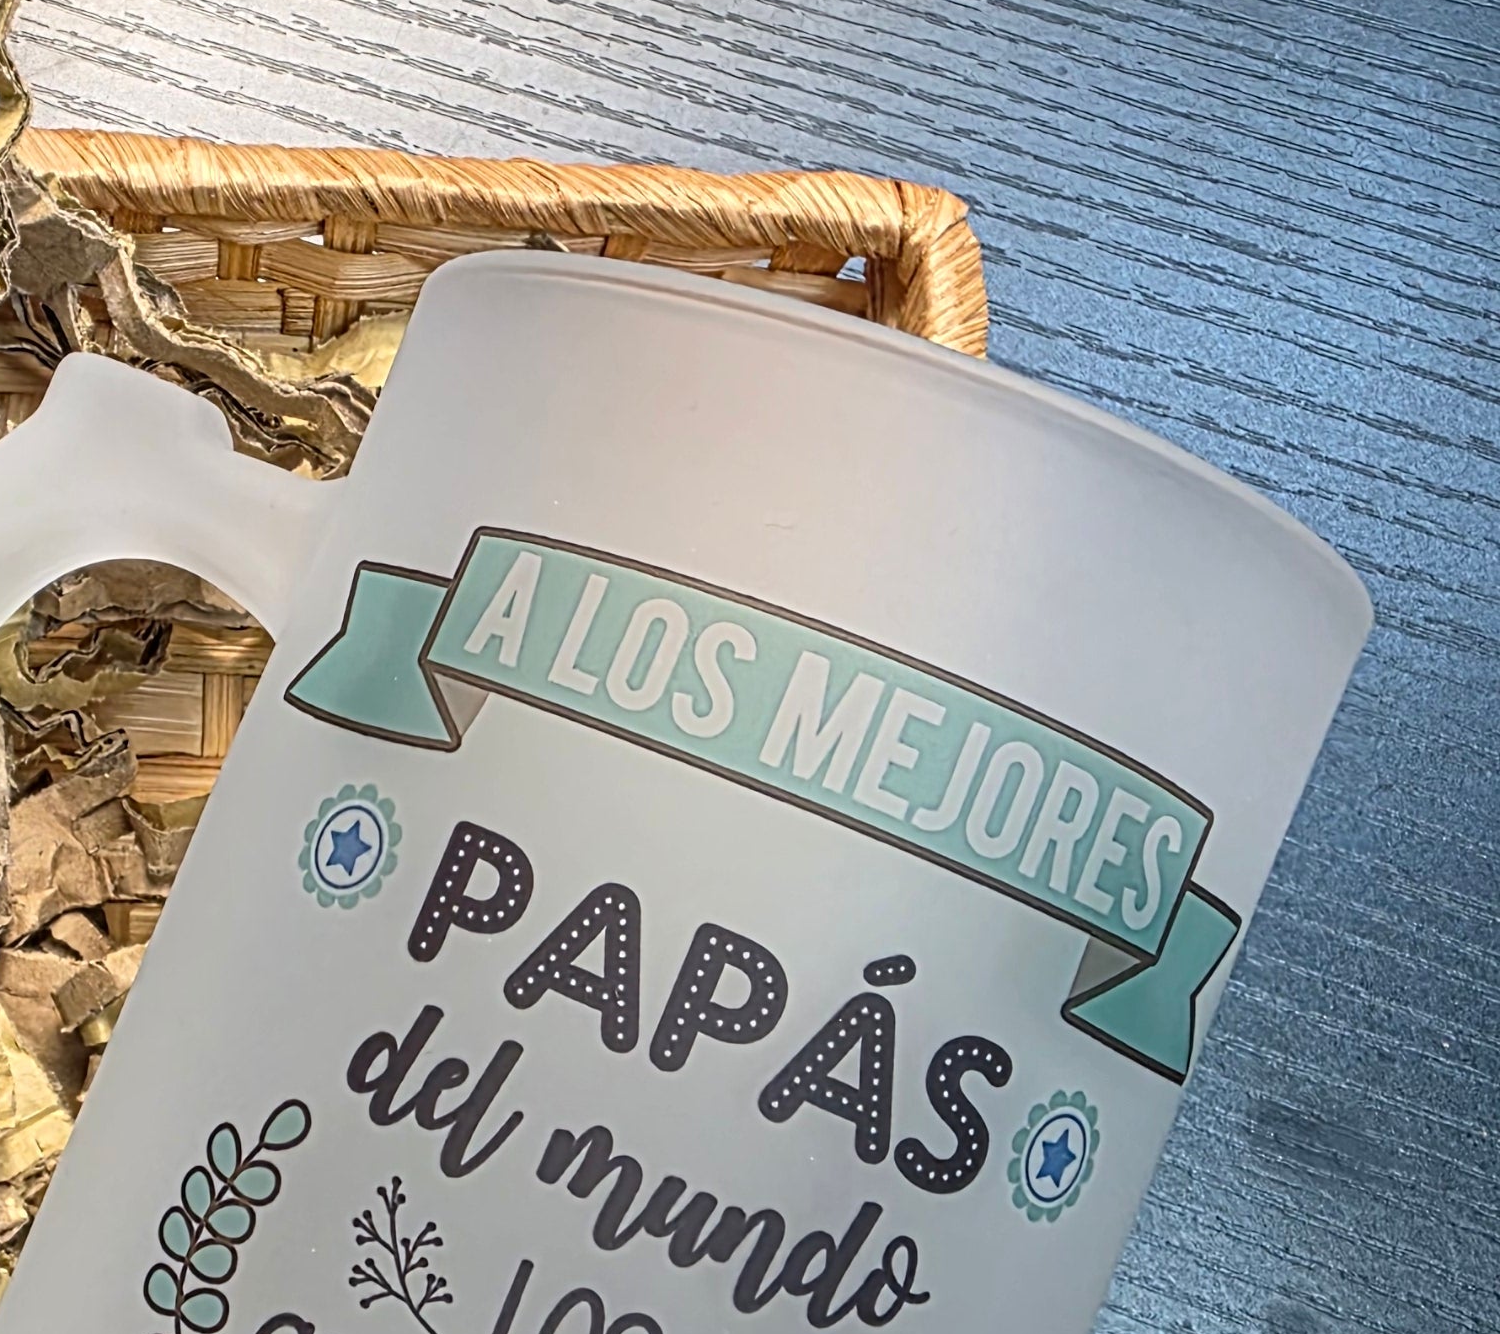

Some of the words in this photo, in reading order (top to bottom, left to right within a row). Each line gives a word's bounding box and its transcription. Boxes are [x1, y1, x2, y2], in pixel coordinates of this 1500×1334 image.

[462, 551, 542, 669] A
[546, 575, 757, 739] LOS
[758, 649, 1183, 931] MEJORES
[346, 1005, 525, 1178] del
[537, 1124, 930, 1329] mundo
[407, 820, 1012, 1195] PAPÁS
